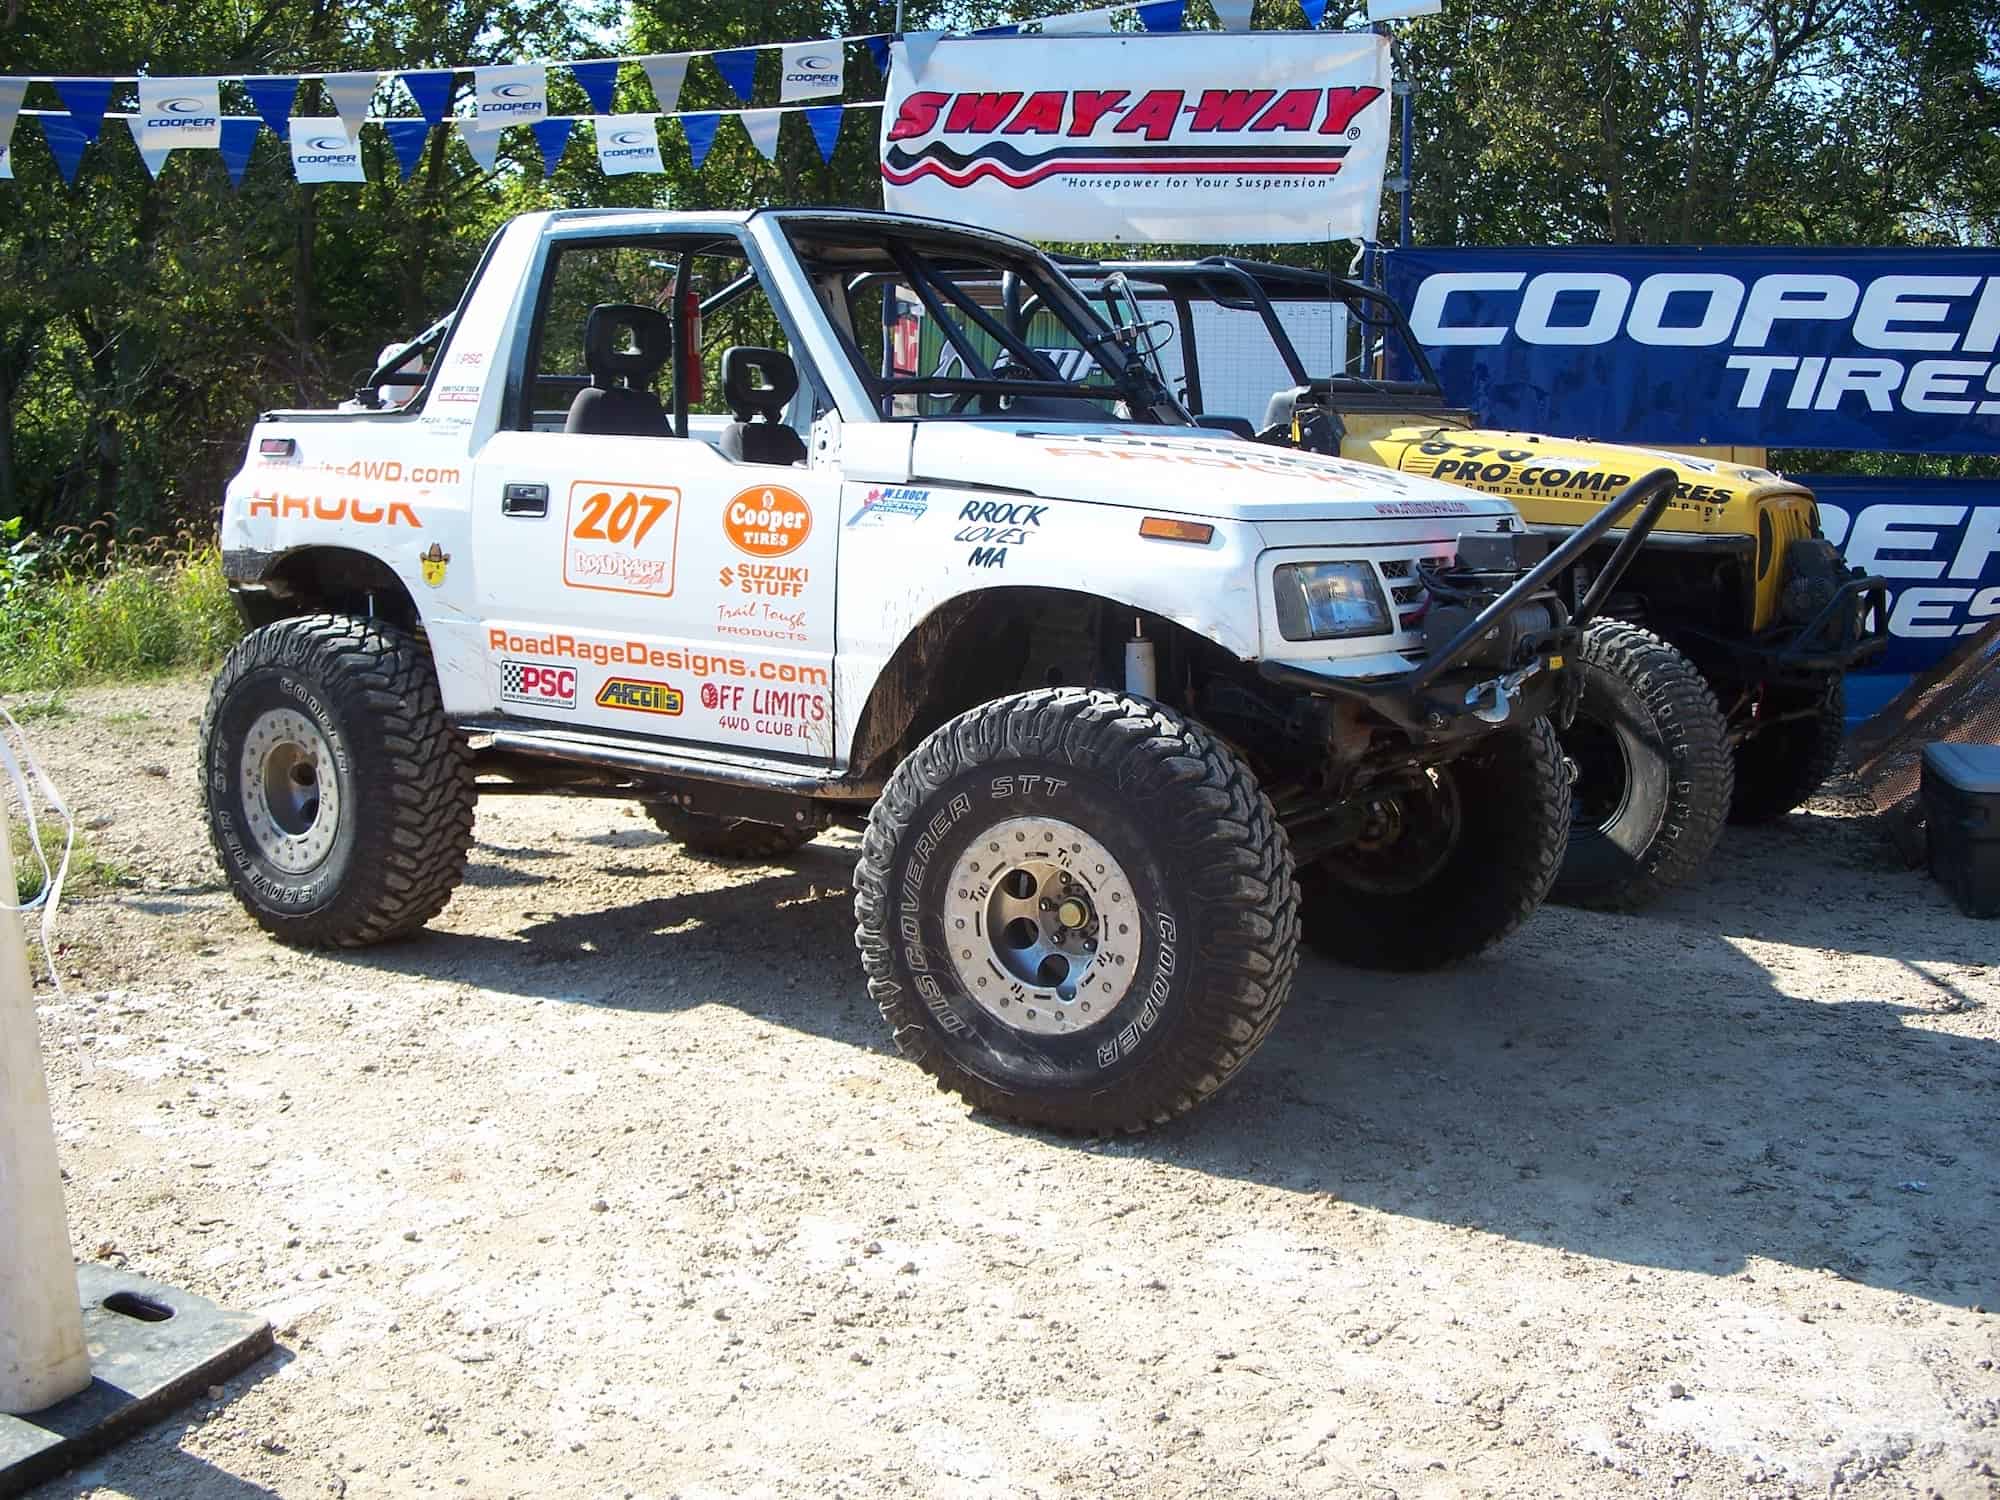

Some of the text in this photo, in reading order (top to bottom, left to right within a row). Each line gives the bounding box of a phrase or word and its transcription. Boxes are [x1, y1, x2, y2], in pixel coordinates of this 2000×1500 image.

[786, 73, 839, 82] COOPER
[481, 101, 542, 112] COOPER
[887, 86, 1384, 142] SWAY-A-WAY
[147, 117, 217, 128] COOPER
[297, 154, 357, 164] COOPER
[603, 147, 655, 158] COOPER
[1165, 176, 1188, 189] for
[1195, 176, 1230, 189] Your
[1431, 458, 1511, 483] PRO
[1519, 466, 1631, 493] COMP
[1464, 481, 1582, 501] Competition
[574, 492, 673, 550] 207
[730, 502, 806, 532] Cooper
[958, 500, 1049, 527] RROCK
[743, 531, 789, 546] TIRES
[953, 525, 1037, 545] LOVES
[967, 546, 1009, 569] MA
[737, 563, 809, 583] SUZUKI
[741, 579, 804, 598] STUFF
[717, 601, 807, 631] Trail Tough
[716, 625, 808, 642] PRODUCTS
[489, 628, 828, 686] RoadRageDesigns.com
[523, 666, 575, 699] PSC
[701, 683, 825, 721] OFF LIMITS
[718, 715, 750, 732] 4WD
[755, 719, 793, 737] CLUB
[990, 774, 1070, 800] STT
[900, 791, 973, 1035] DISCOVERER
[1097, 911, 1177, 1069] COOPER
